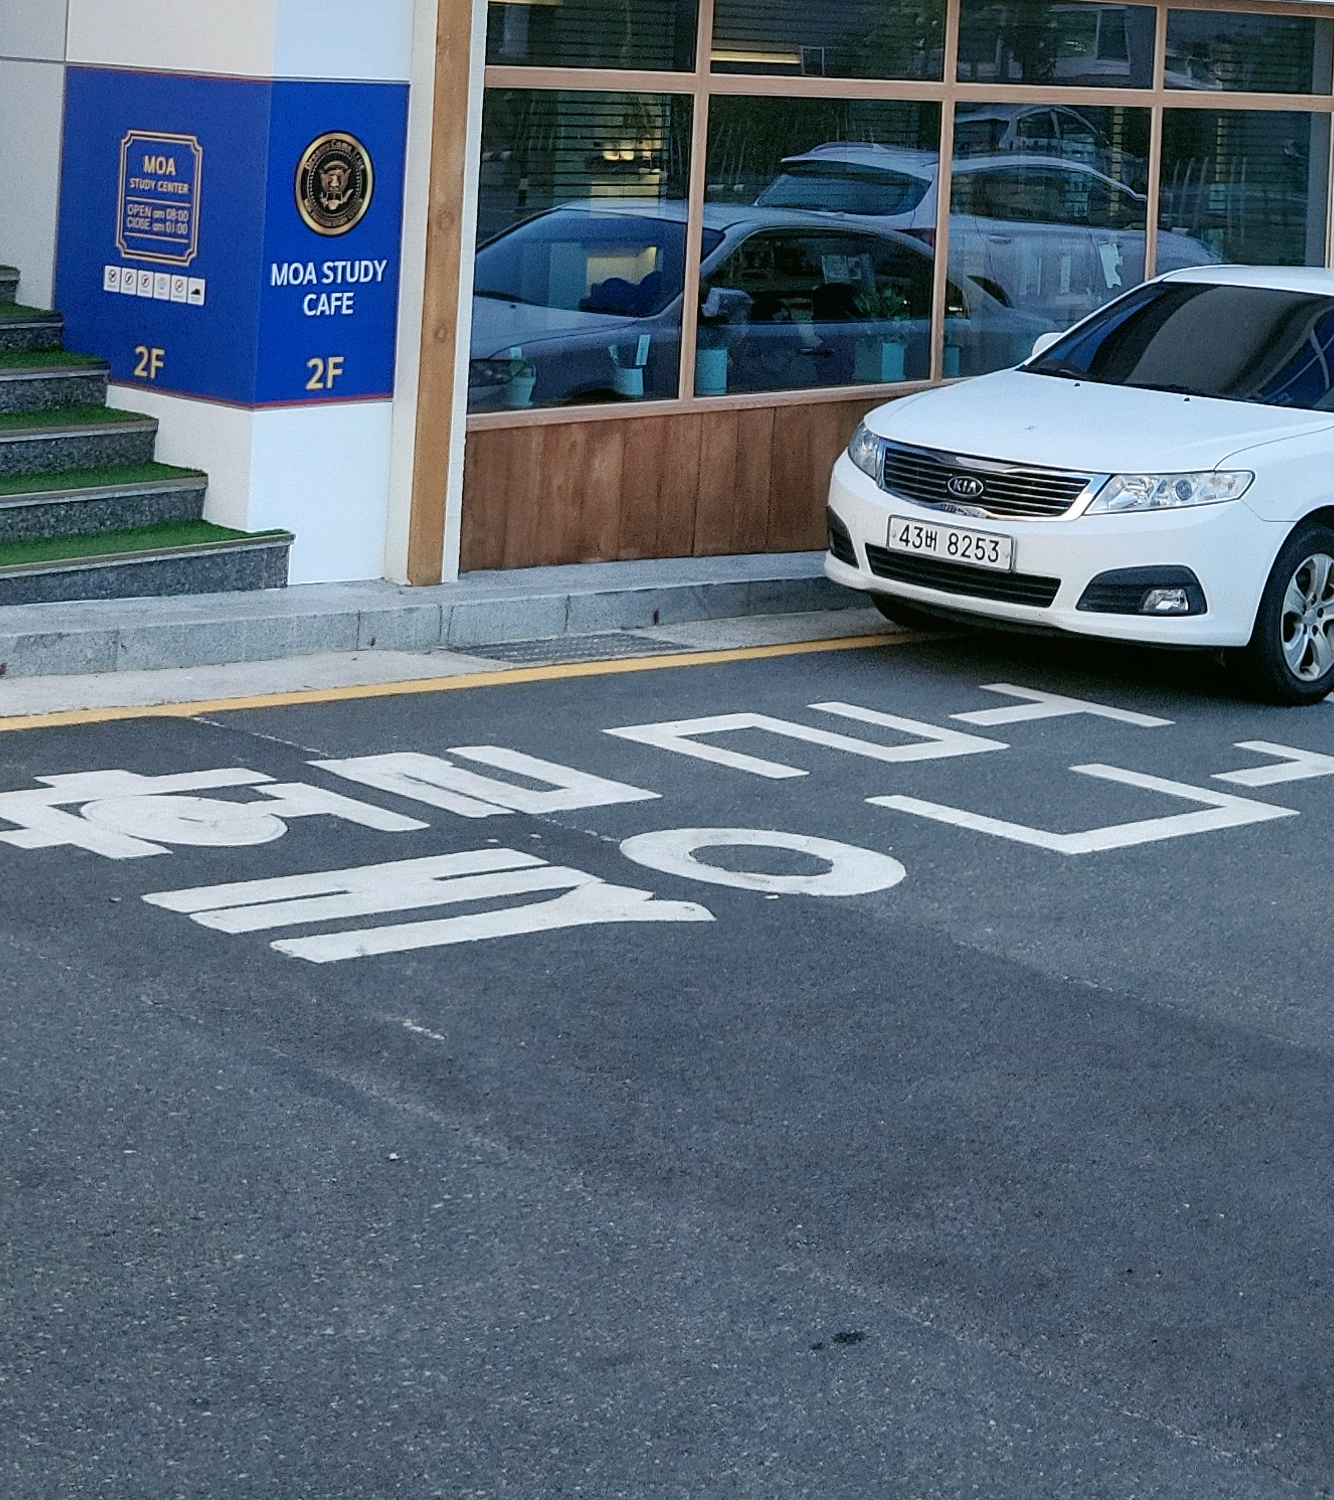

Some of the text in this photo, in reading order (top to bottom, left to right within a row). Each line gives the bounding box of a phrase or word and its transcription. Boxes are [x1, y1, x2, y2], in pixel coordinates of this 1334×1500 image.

[143, 155, 176, 176] MOA
[129, 177, 189, 195] STUDY CENTER
[127, 203, 152, 217] OPEN
[270, 259, 387, 286] MOA STUDY
[303, 292, 355, 316] CAFE
[133, 345, 165, 379] 2F
[305, 356, 345, 390] 2F
[953, 479, 977, 494] KIA
[898, 523, 1000, 563] 43버 8253
